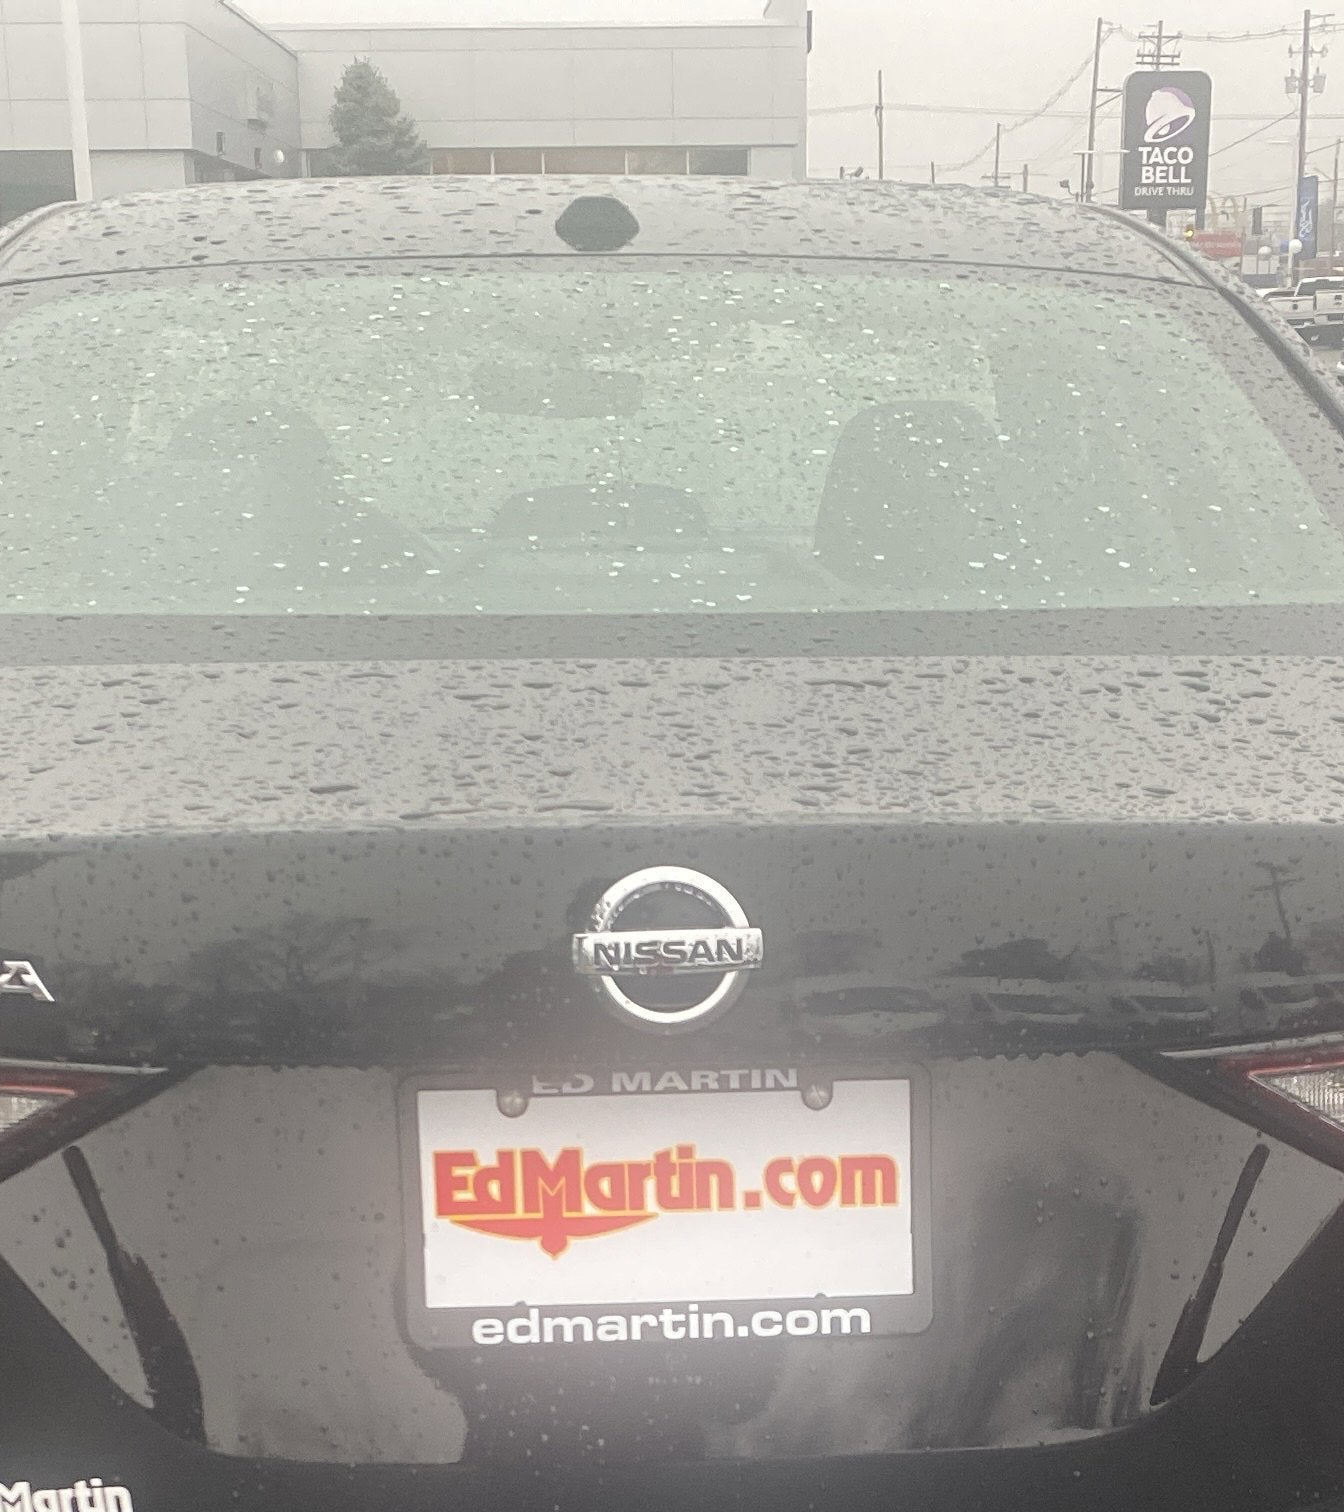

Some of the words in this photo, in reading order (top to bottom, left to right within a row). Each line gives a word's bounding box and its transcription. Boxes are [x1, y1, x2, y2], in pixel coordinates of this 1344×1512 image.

[1138, 146, 1194, 165] TACO
[1141, 165, 1192, 184] BELL
[1134, 186, 1164, 196] DRIVE
[1166, 186, 1194, 196] THRU
[593, 937, 744, 966] NISSAN
[610, 1067, 799, 1093] MARTIN
[432, 1144, 900, 1224] EdMartin.com
[471, 1303, 872, 1346] edmartin.com
